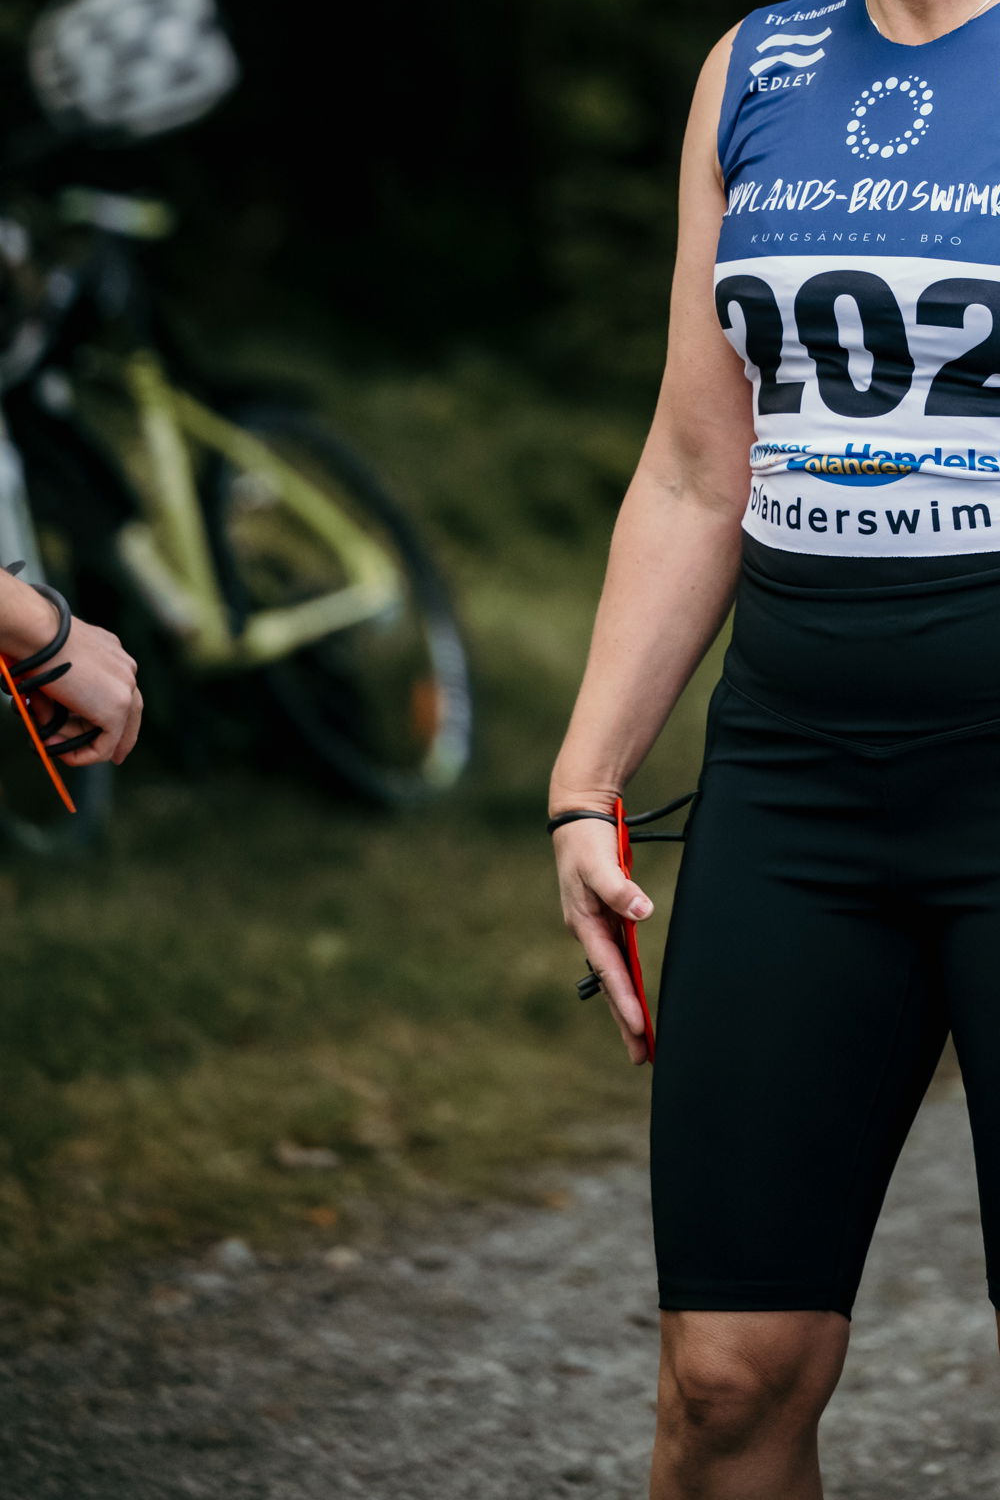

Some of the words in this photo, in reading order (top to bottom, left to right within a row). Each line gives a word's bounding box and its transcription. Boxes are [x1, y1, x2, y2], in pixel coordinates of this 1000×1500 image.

[750, 230, 887, 244] KUNGSÄNGEN
[920, 233, 962, 246] BRO
[804, 454, 914, 476] olander
